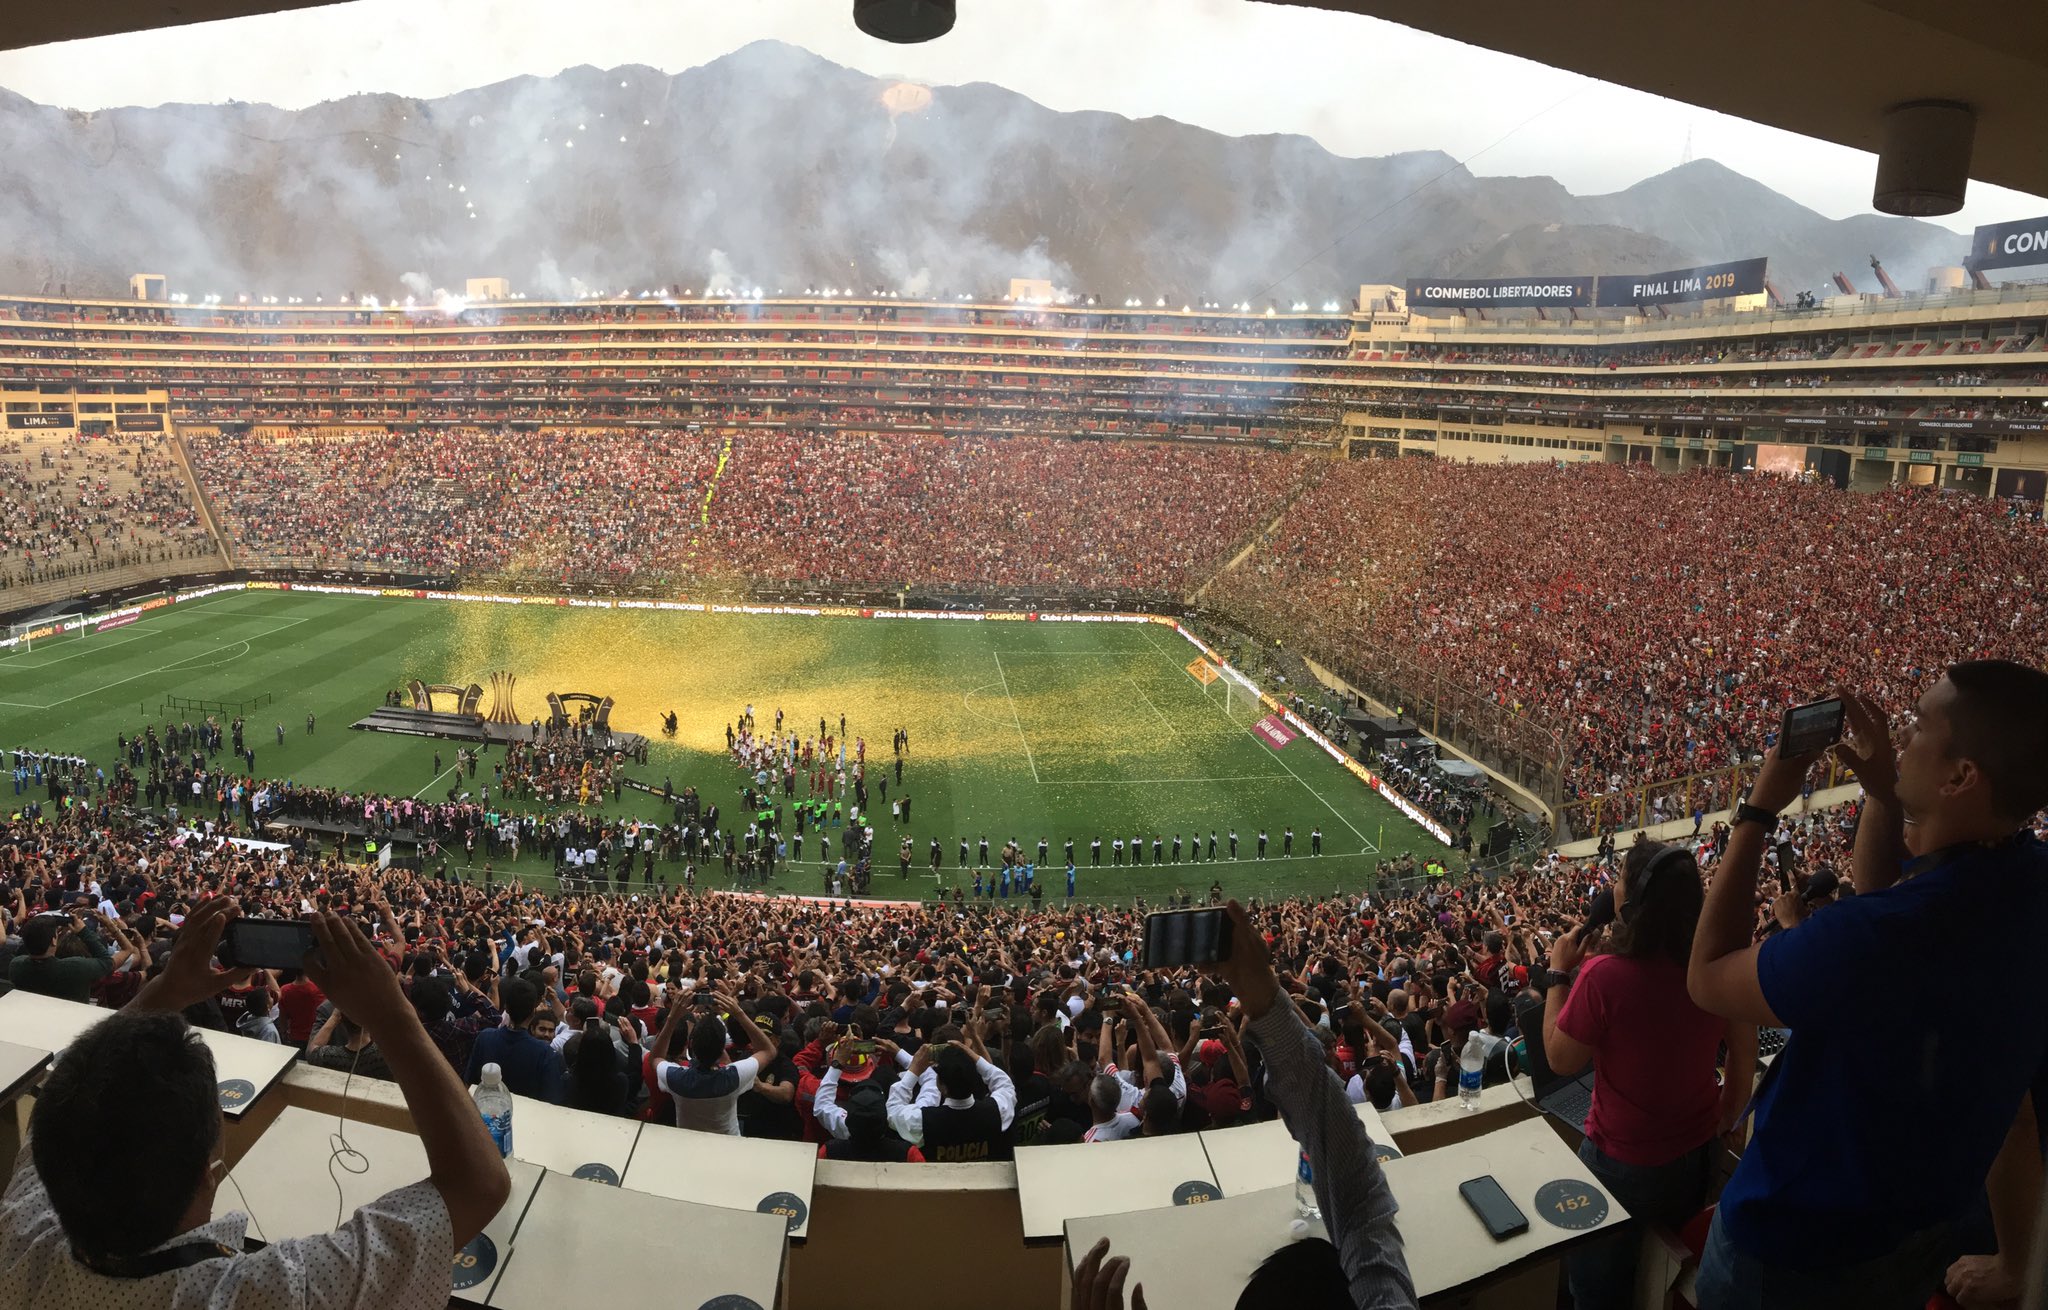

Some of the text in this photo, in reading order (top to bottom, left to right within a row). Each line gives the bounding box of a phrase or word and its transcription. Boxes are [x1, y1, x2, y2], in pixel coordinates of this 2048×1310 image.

[1633, 272, 1735, 298] FINAL LIMA 2019
[1425, 285, 1573, 299] CONMEBOL LIBERTADORES
[24, 417, 48, 425] LIMA
[1911, 452, 1930, 460] SALIDA
[1959, 455, 1980, 464] SALIDA
[351, 587, 381, 597] Flamengo
[493, 595, 522, 604] Flamengo
[618, 601, 705, 611] CONMEBOL LIBERTADORES
[784, 607, 820, 616] Flamengo
[898, 611, 907, 619] de
[908, 612, 937, 620] Regatas
[950, 613, 984, 621] Flamengo
[985, 613, 1026, 621] CAMPEÓN!
[1040, 613, 1061, 621] Clube
[1073, 614, 1102, 623] Regatas
[1113, 615, 1148, 624] Flamengo
[64, 620, 80, 631] Clube
[1379, 783, 1395, 803] Clube
[1394, 796, 1402, 809] de
[1401, 799, 1426, 827] Regatas
[1425, 818, 1435, 833] do
[936, 1140, 989, 1161] POLICIA
[1555, 1195, 1590, 1214] 152
[453, 1253, 478, 1269] 49
